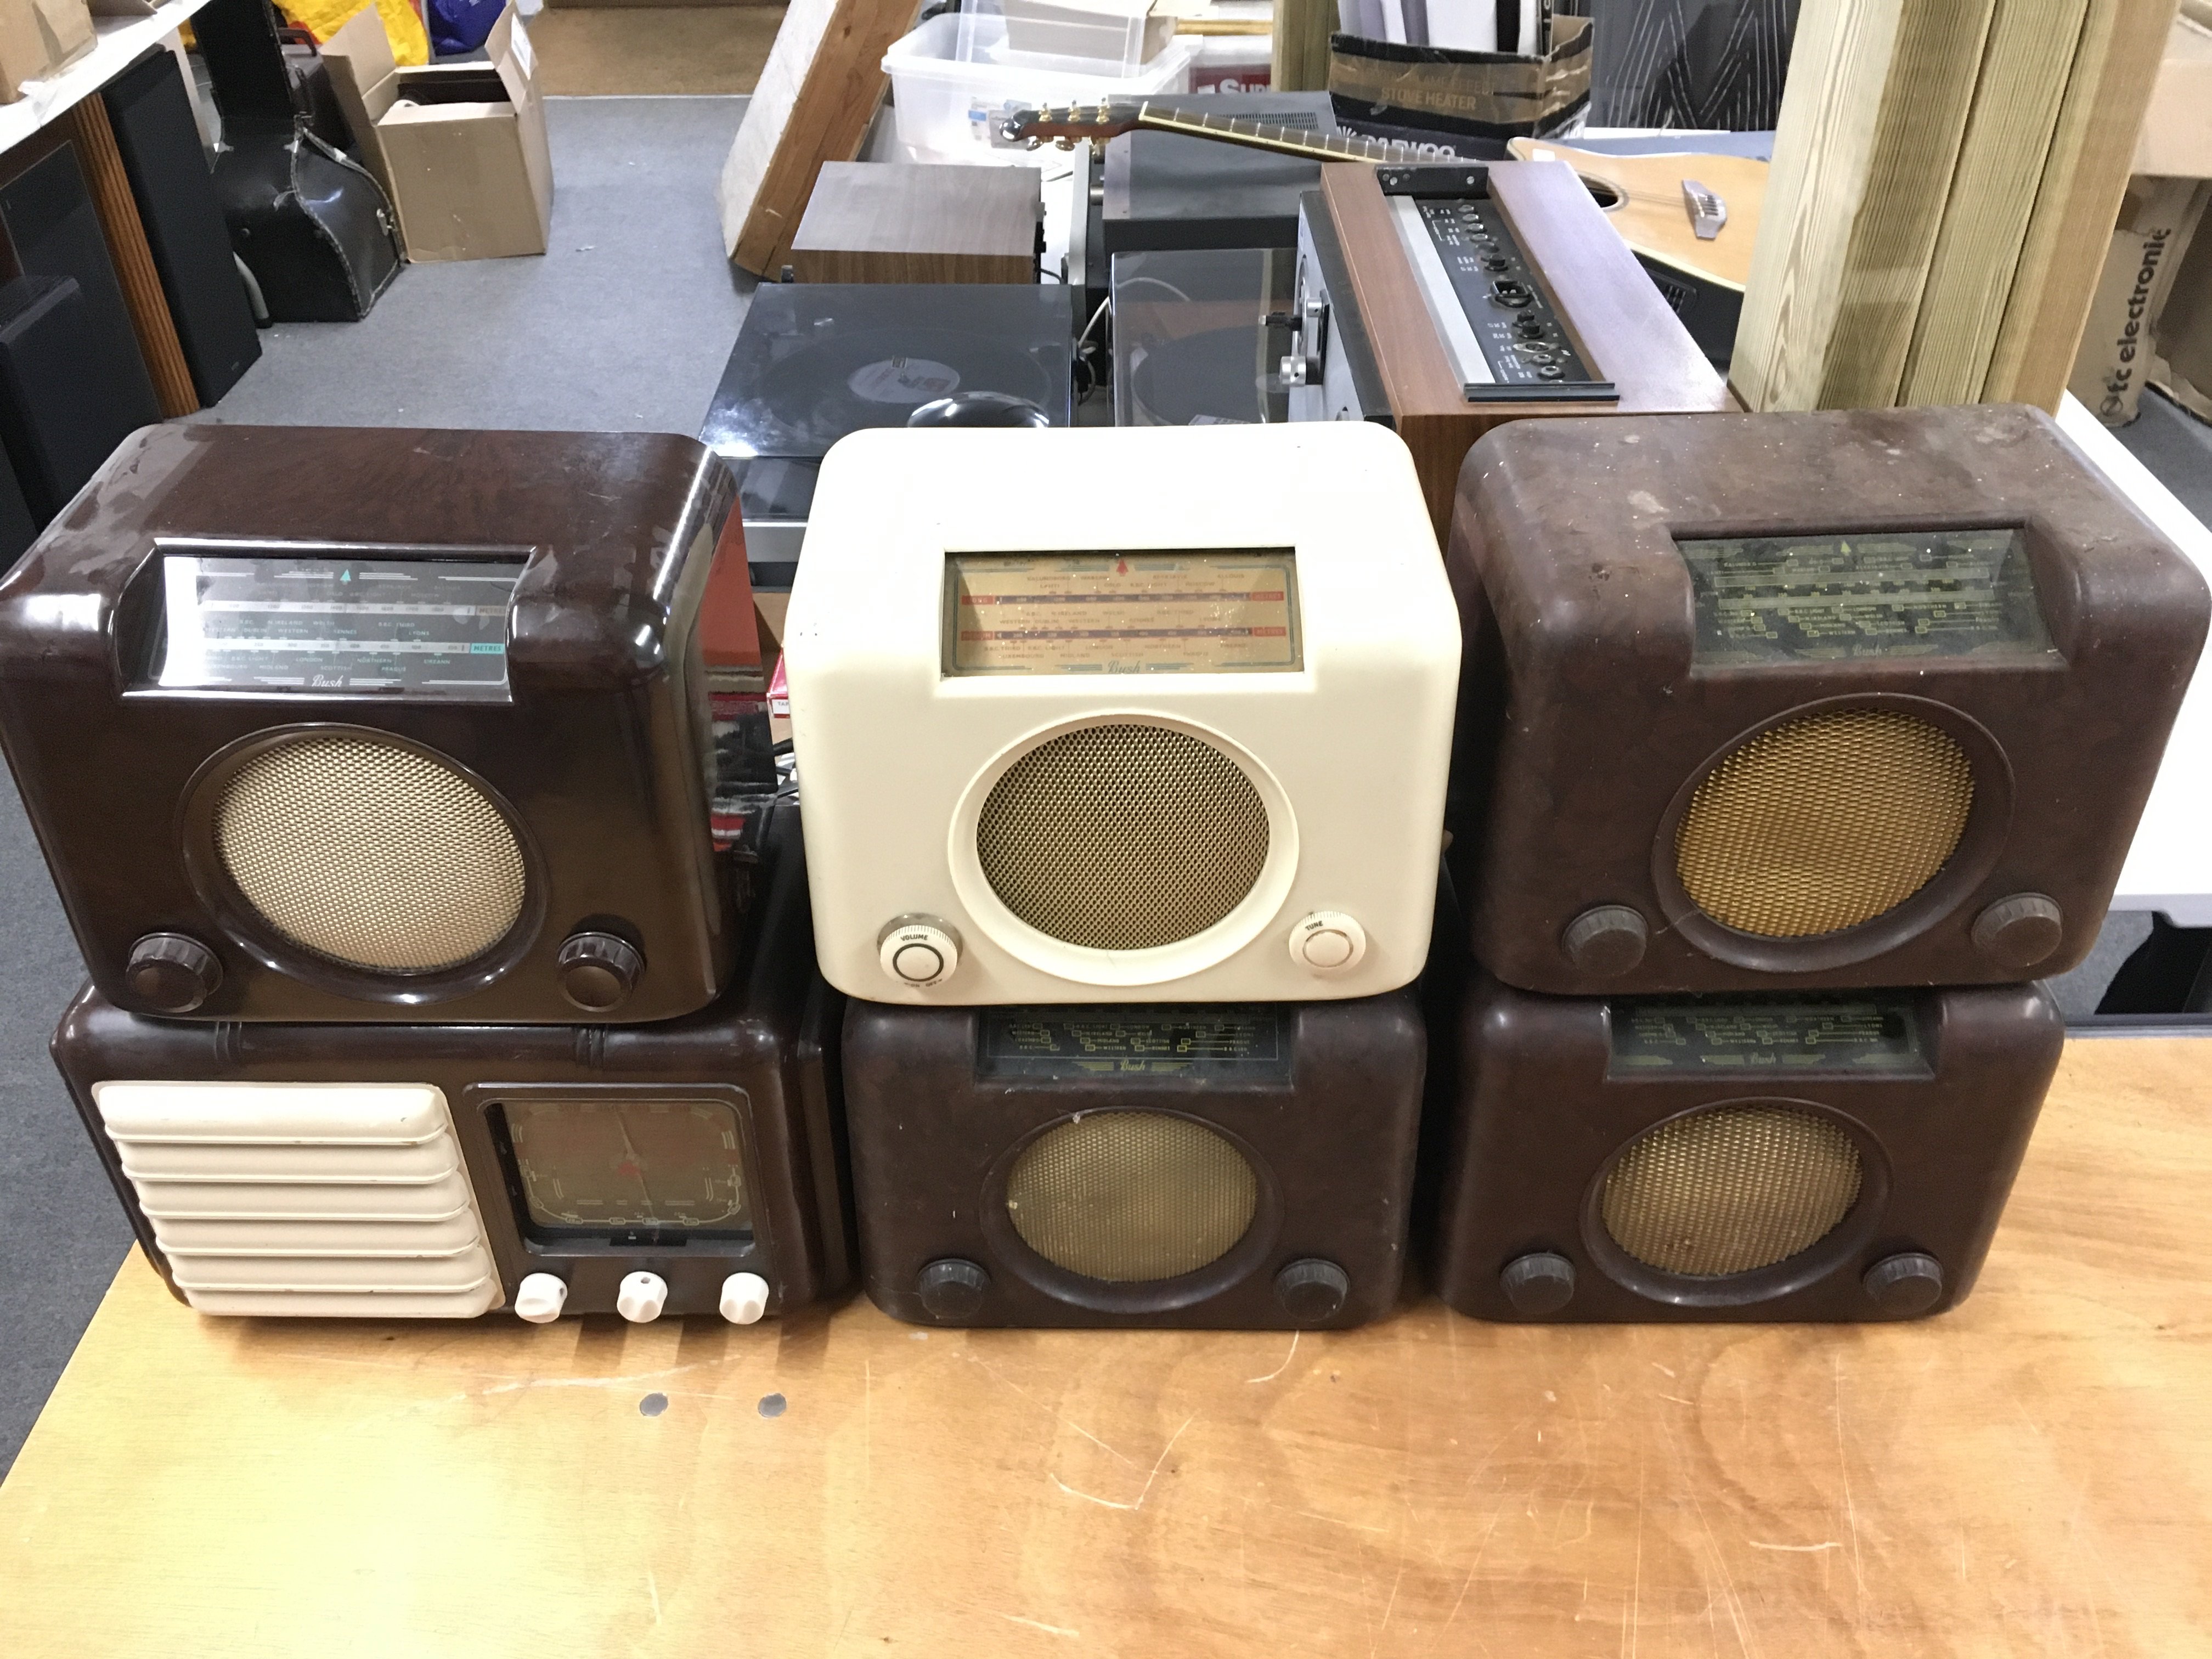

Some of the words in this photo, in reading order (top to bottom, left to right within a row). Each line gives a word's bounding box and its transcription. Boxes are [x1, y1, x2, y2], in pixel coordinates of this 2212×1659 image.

[1381, 87, 1423, 104] STOVE
[1426, 92, 1476, 110] HEATER
[1852, 644, 1882, 657] Bush
[1108, 659, 1141, 674] Bush
[311, 674, 344, 687] Bush
[1305, 920, 1324, 931] TUNE
[1120, 1058, 1146, 1071] Bush
